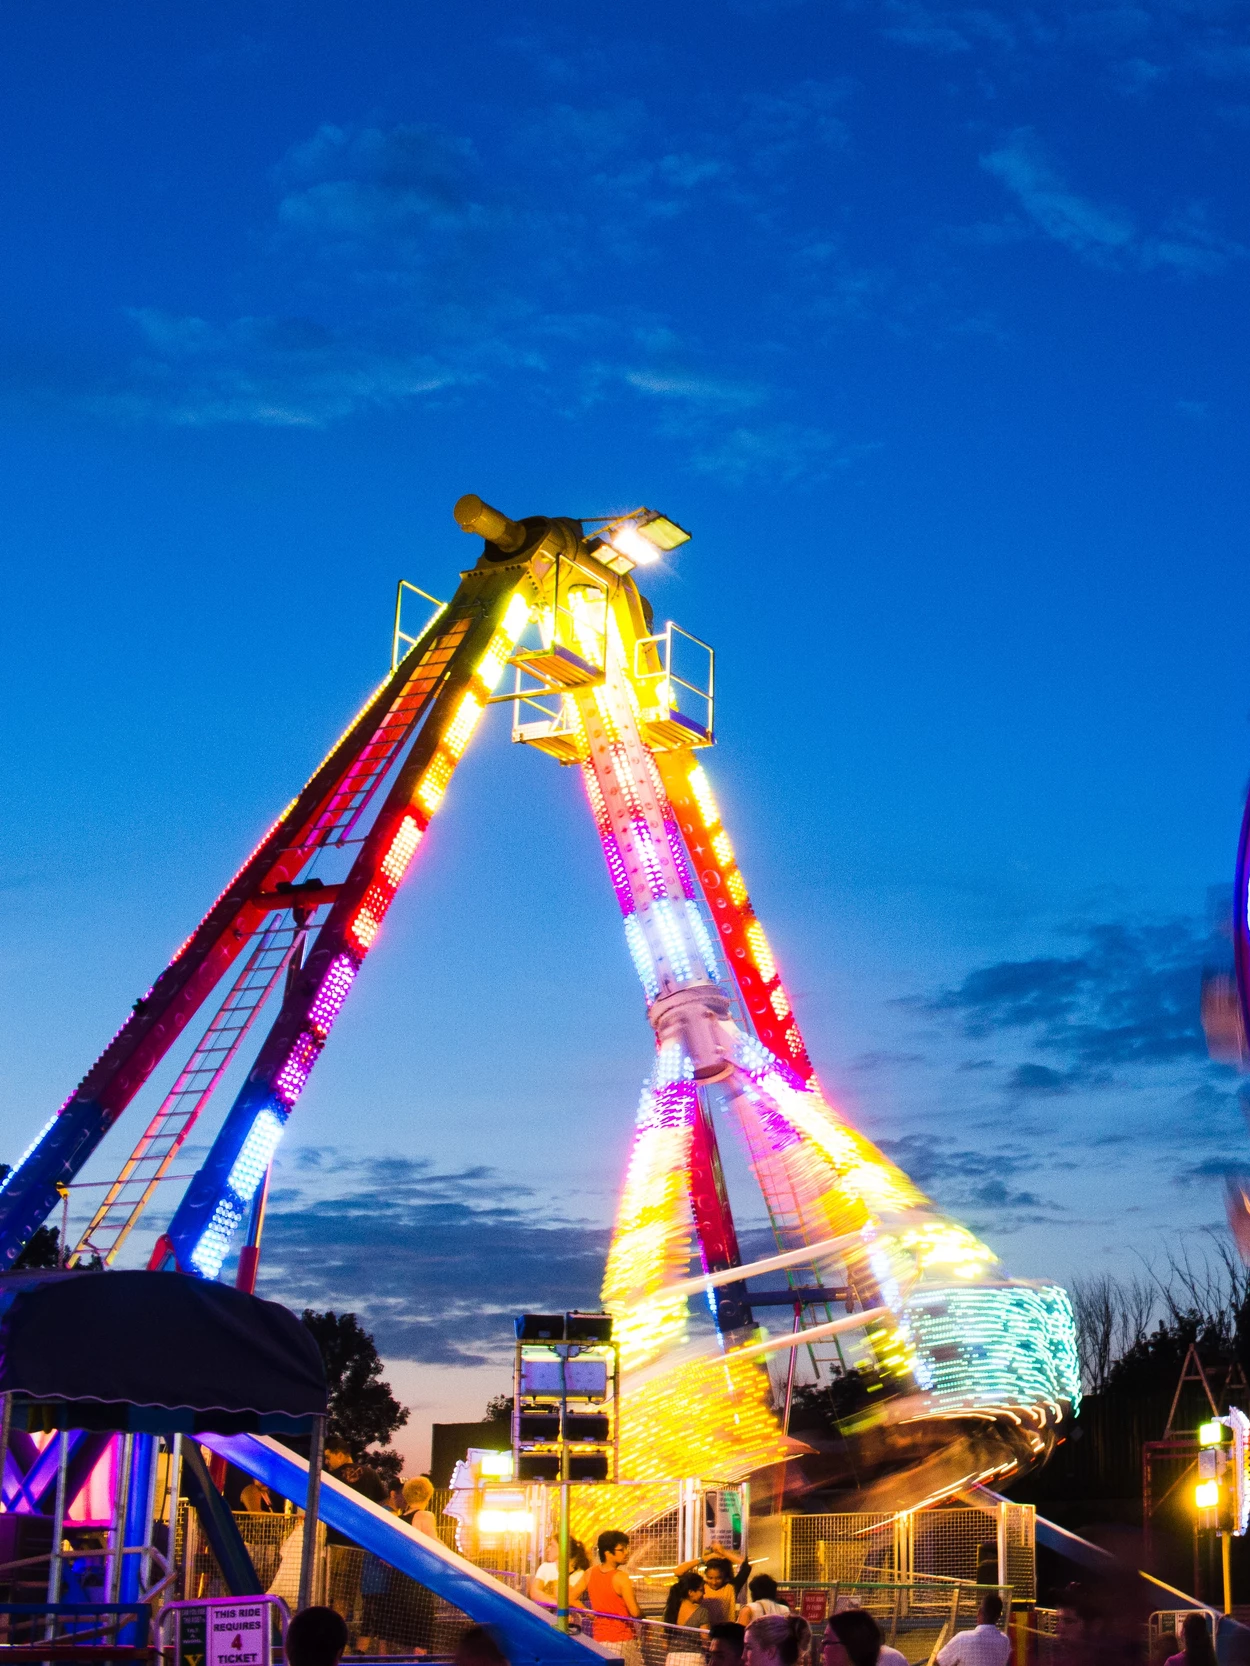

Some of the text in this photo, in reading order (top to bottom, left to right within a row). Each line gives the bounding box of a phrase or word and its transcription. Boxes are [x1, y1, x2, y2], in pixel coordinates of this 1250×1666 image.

[214, 1609, 236, 1618] THIS
[238, 1607, 261, 1617] RIDE
[213, 1620, 261, 1632] REQUIRES
[230, 1633, 243, 1651] 4
[217, 1653, 258, 1664] TICKET
